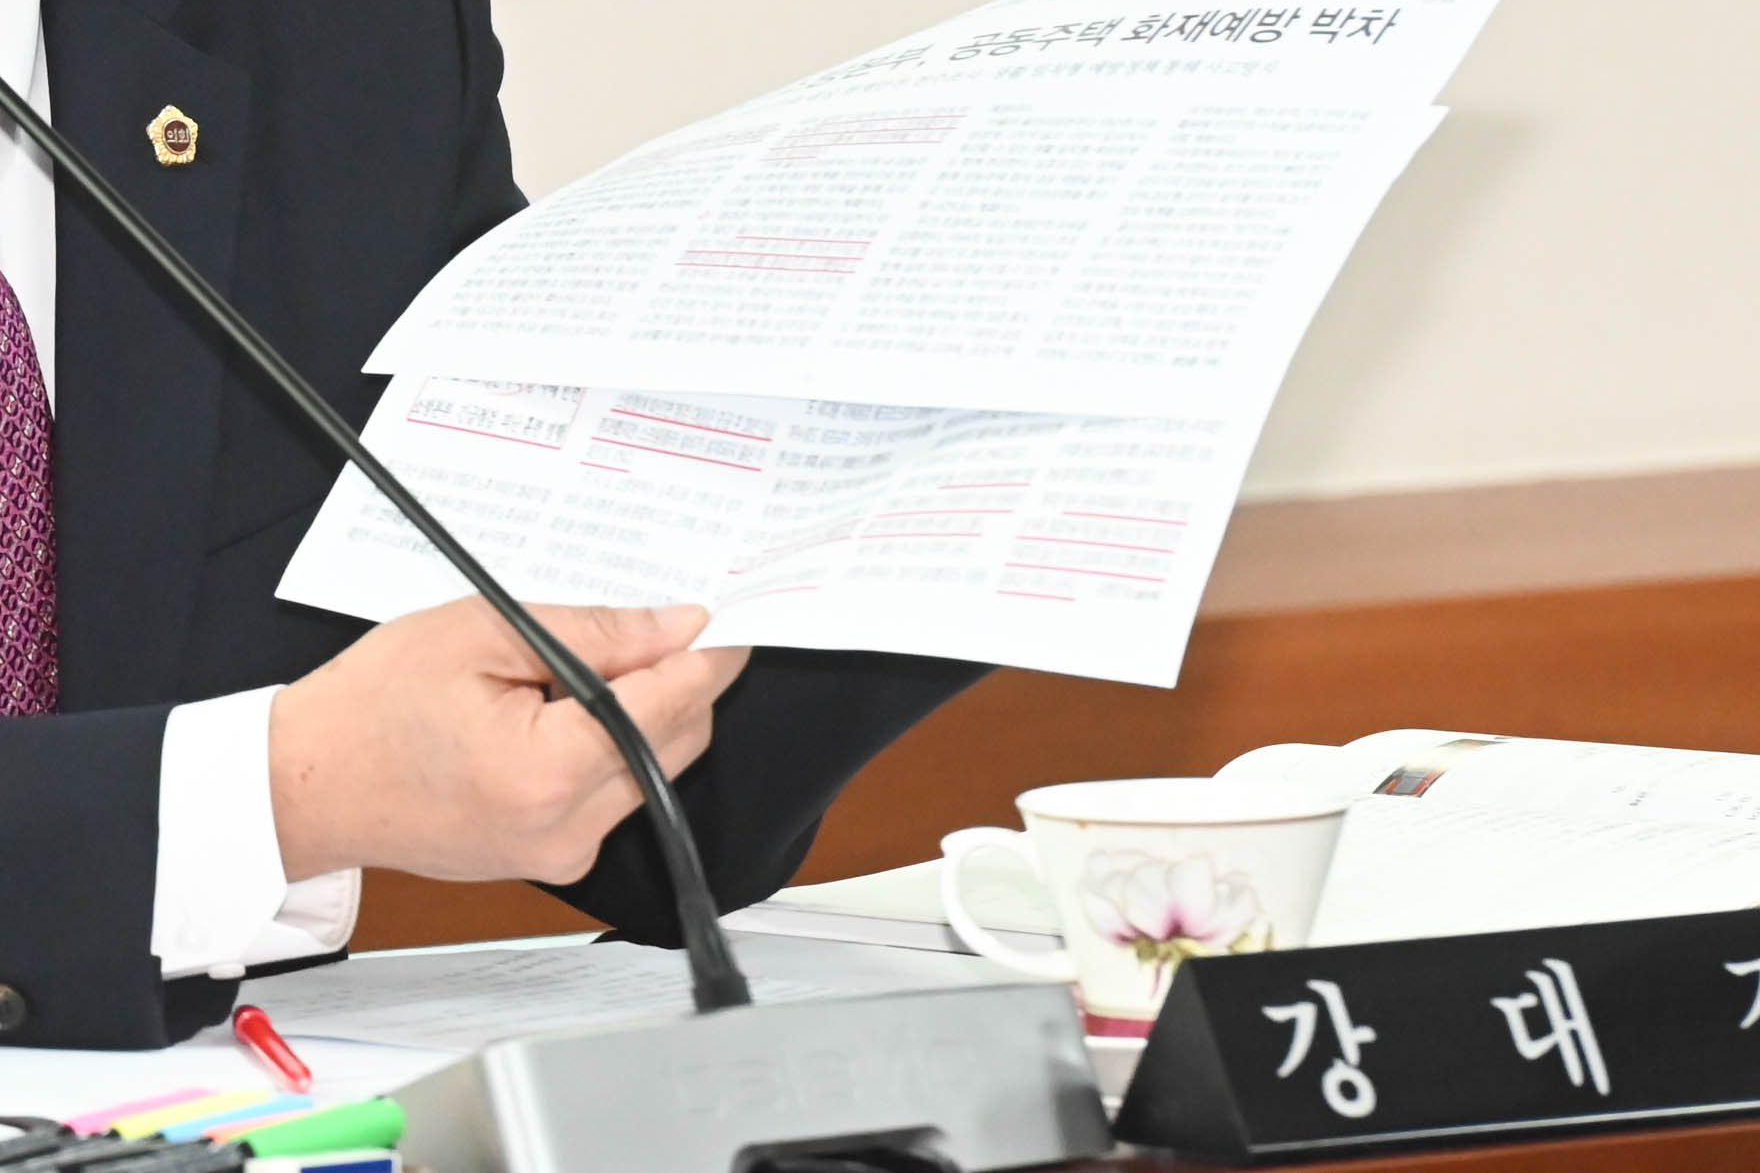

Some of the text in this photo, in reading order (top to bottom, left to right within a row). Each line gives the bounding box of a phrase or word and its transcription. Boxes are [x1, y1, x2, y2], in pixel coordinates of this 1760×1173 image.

[948, 16, 1126, 61] 공동주택
[1120, 7, 1302, 45] 화재예방
[1308, 7, 1402, 46] 박차
